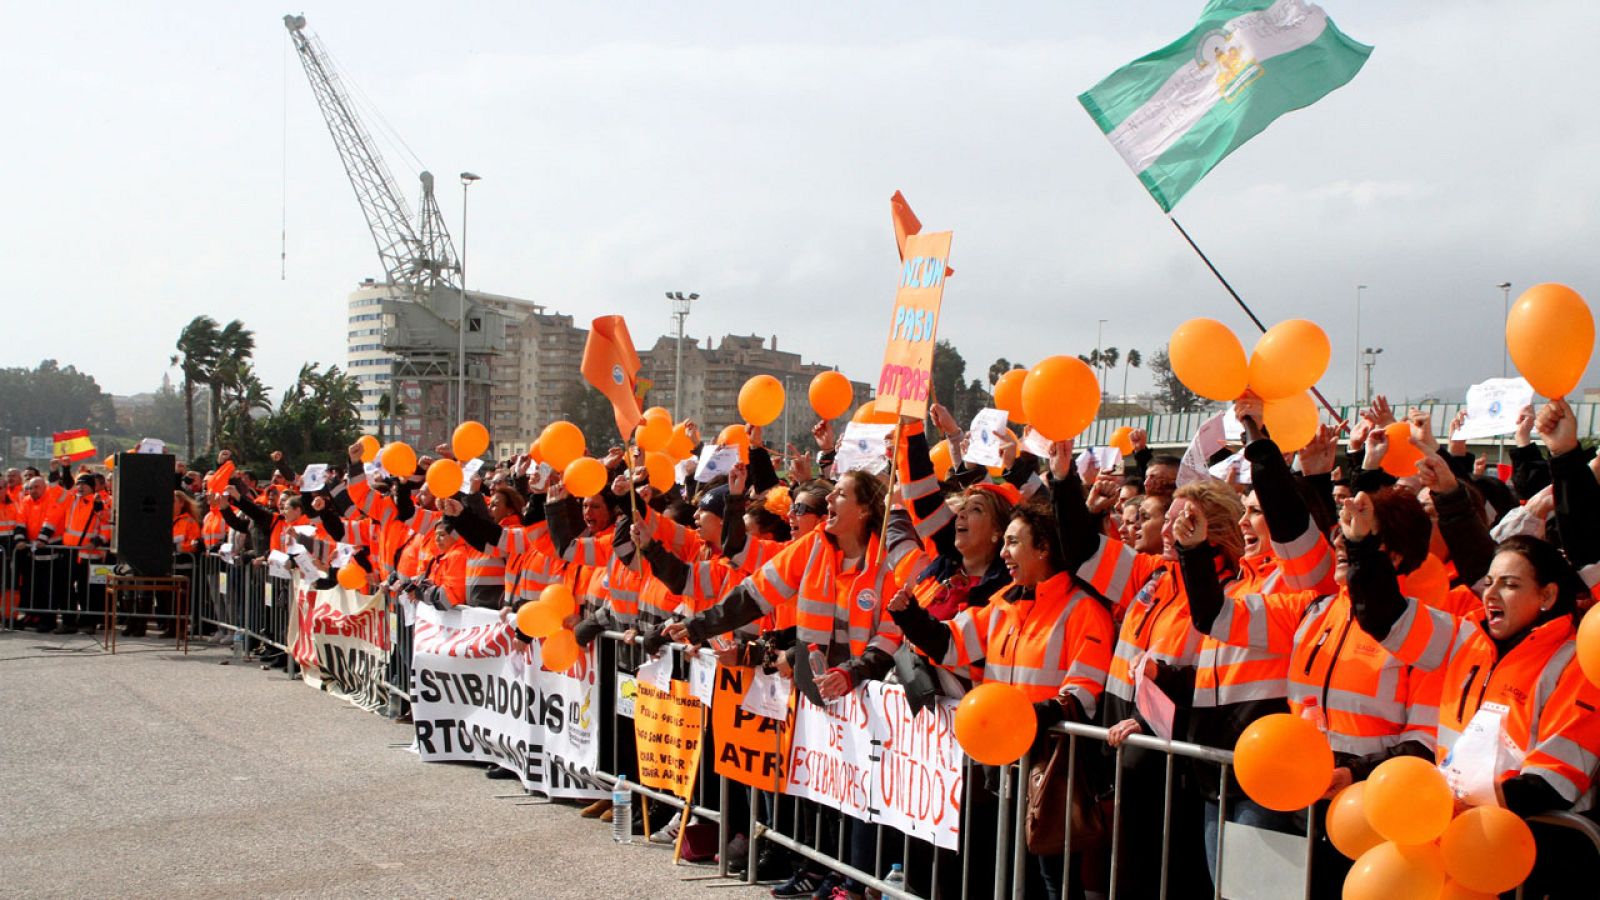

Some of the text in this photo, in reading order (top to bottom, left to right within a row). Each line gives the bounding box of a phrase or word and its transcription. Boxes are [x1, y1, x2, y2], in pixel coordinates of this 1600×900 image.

[901, 256, 924, 289] NI
[893, 305, 935, 343] PASO
[829, 722, 844, 751] DE
[789, 745, 869, 813] ESTIBADORES
